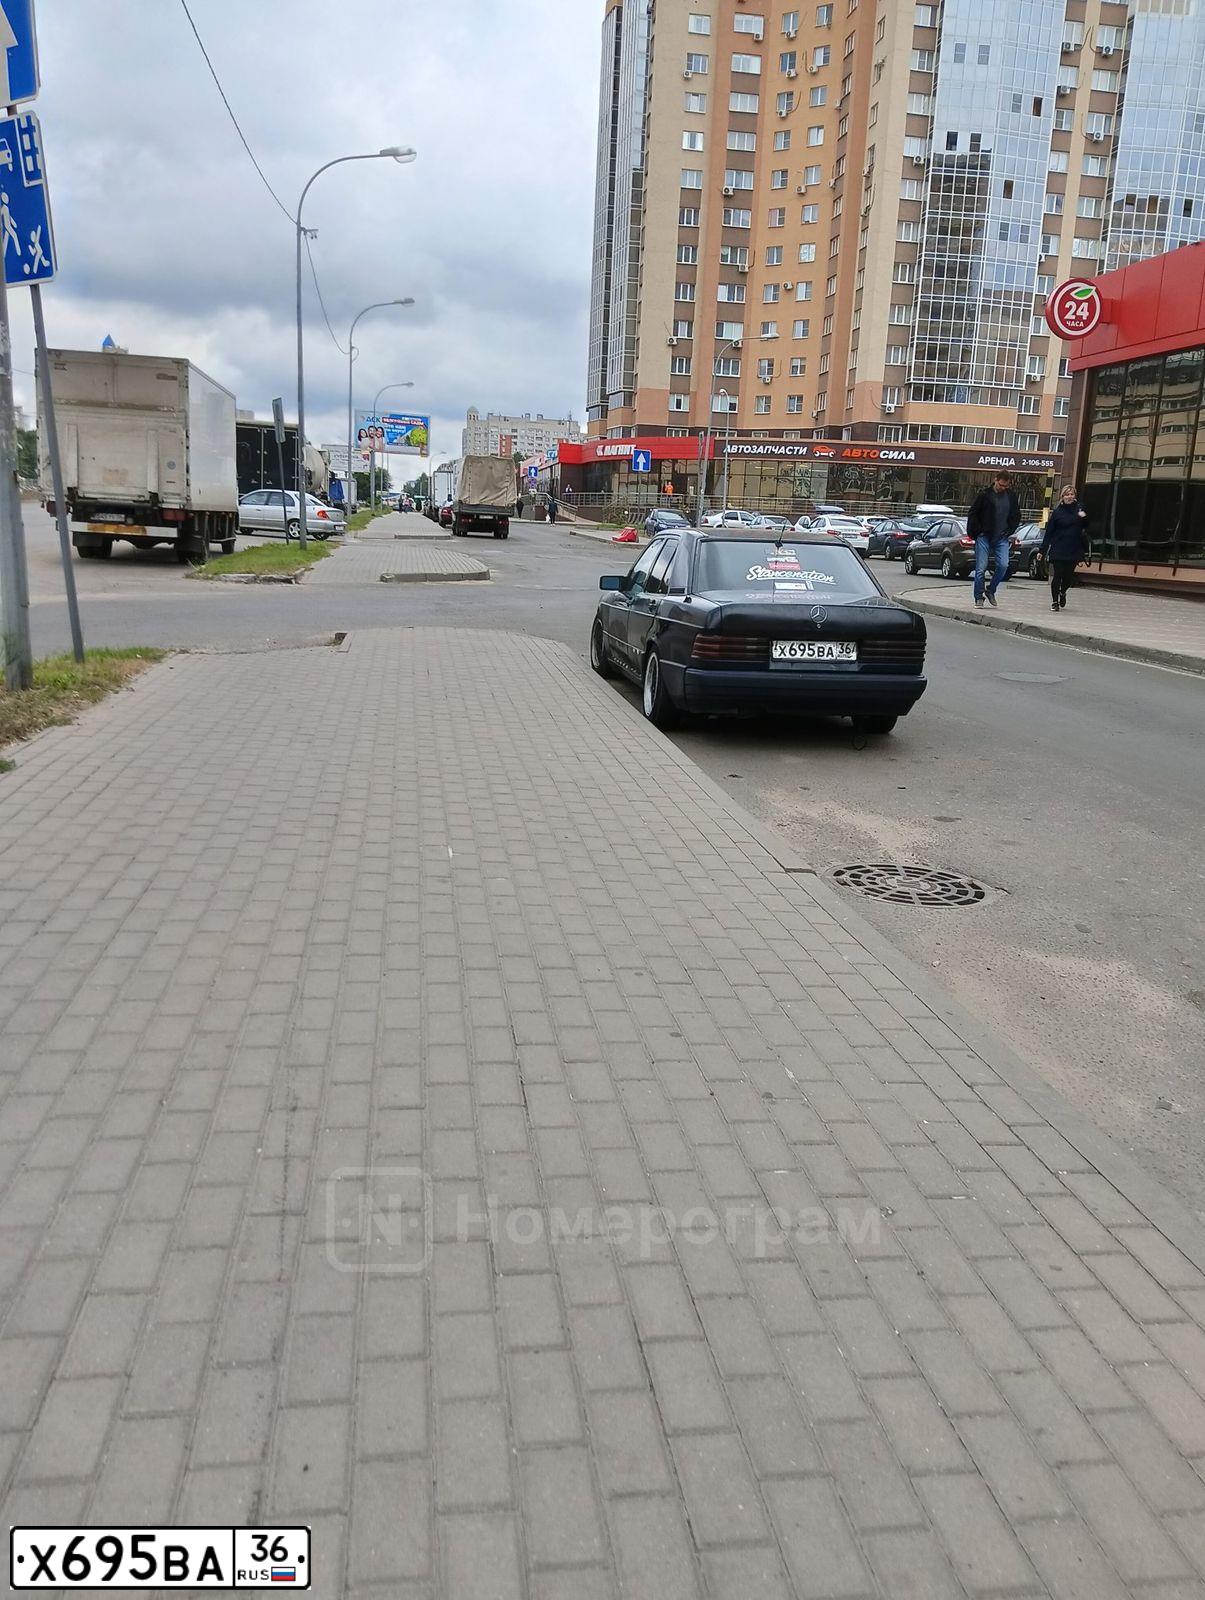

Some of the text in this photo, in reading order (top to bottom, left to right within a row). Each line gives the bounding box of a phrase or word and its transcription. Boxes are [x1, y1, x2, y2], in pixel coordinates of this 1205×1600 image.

[1064, 301, 1089, 320] 24
[723, 445, 808, 455] АВТОЗАПЧАСТИ
[842, 449, 915, 460] АВТОСИЛА
[978, 455, 1016, 467] АРЕНДА
[778, 643, 852, 658] Х695ВА 36
